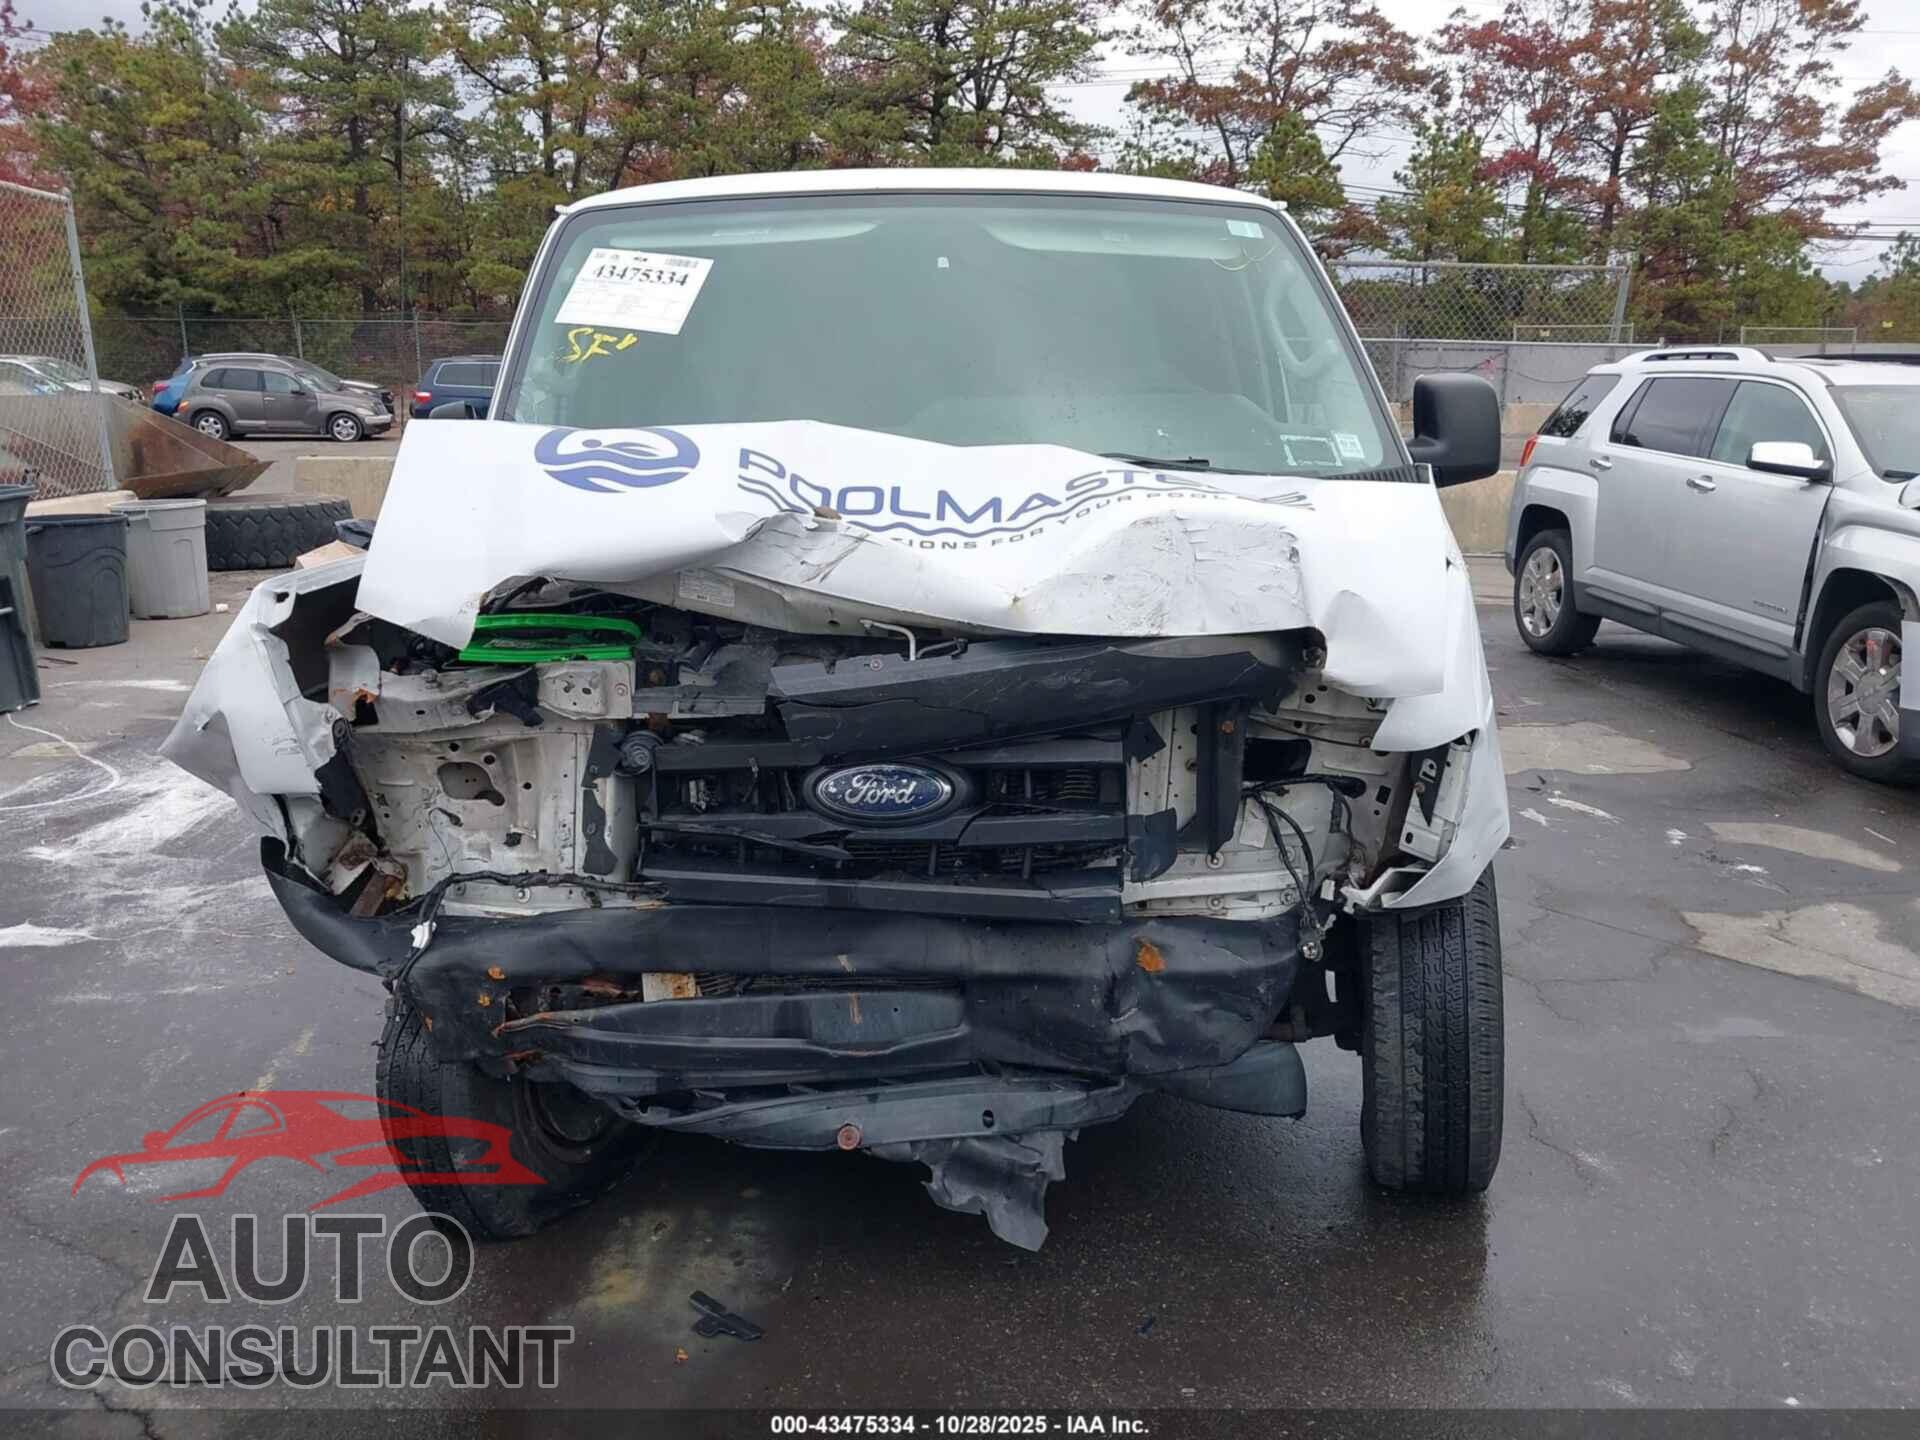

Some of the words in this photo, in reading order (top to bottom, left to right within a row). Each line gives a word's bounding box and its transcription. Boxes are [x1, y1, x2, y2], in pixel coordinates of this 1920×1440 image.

[592, 263, 690, 287] 43475334
[991, 527, 1044, 547] FOR
[1057, 494, 1132, 525] YOUR
[844, 773, 917, 804] Ford
